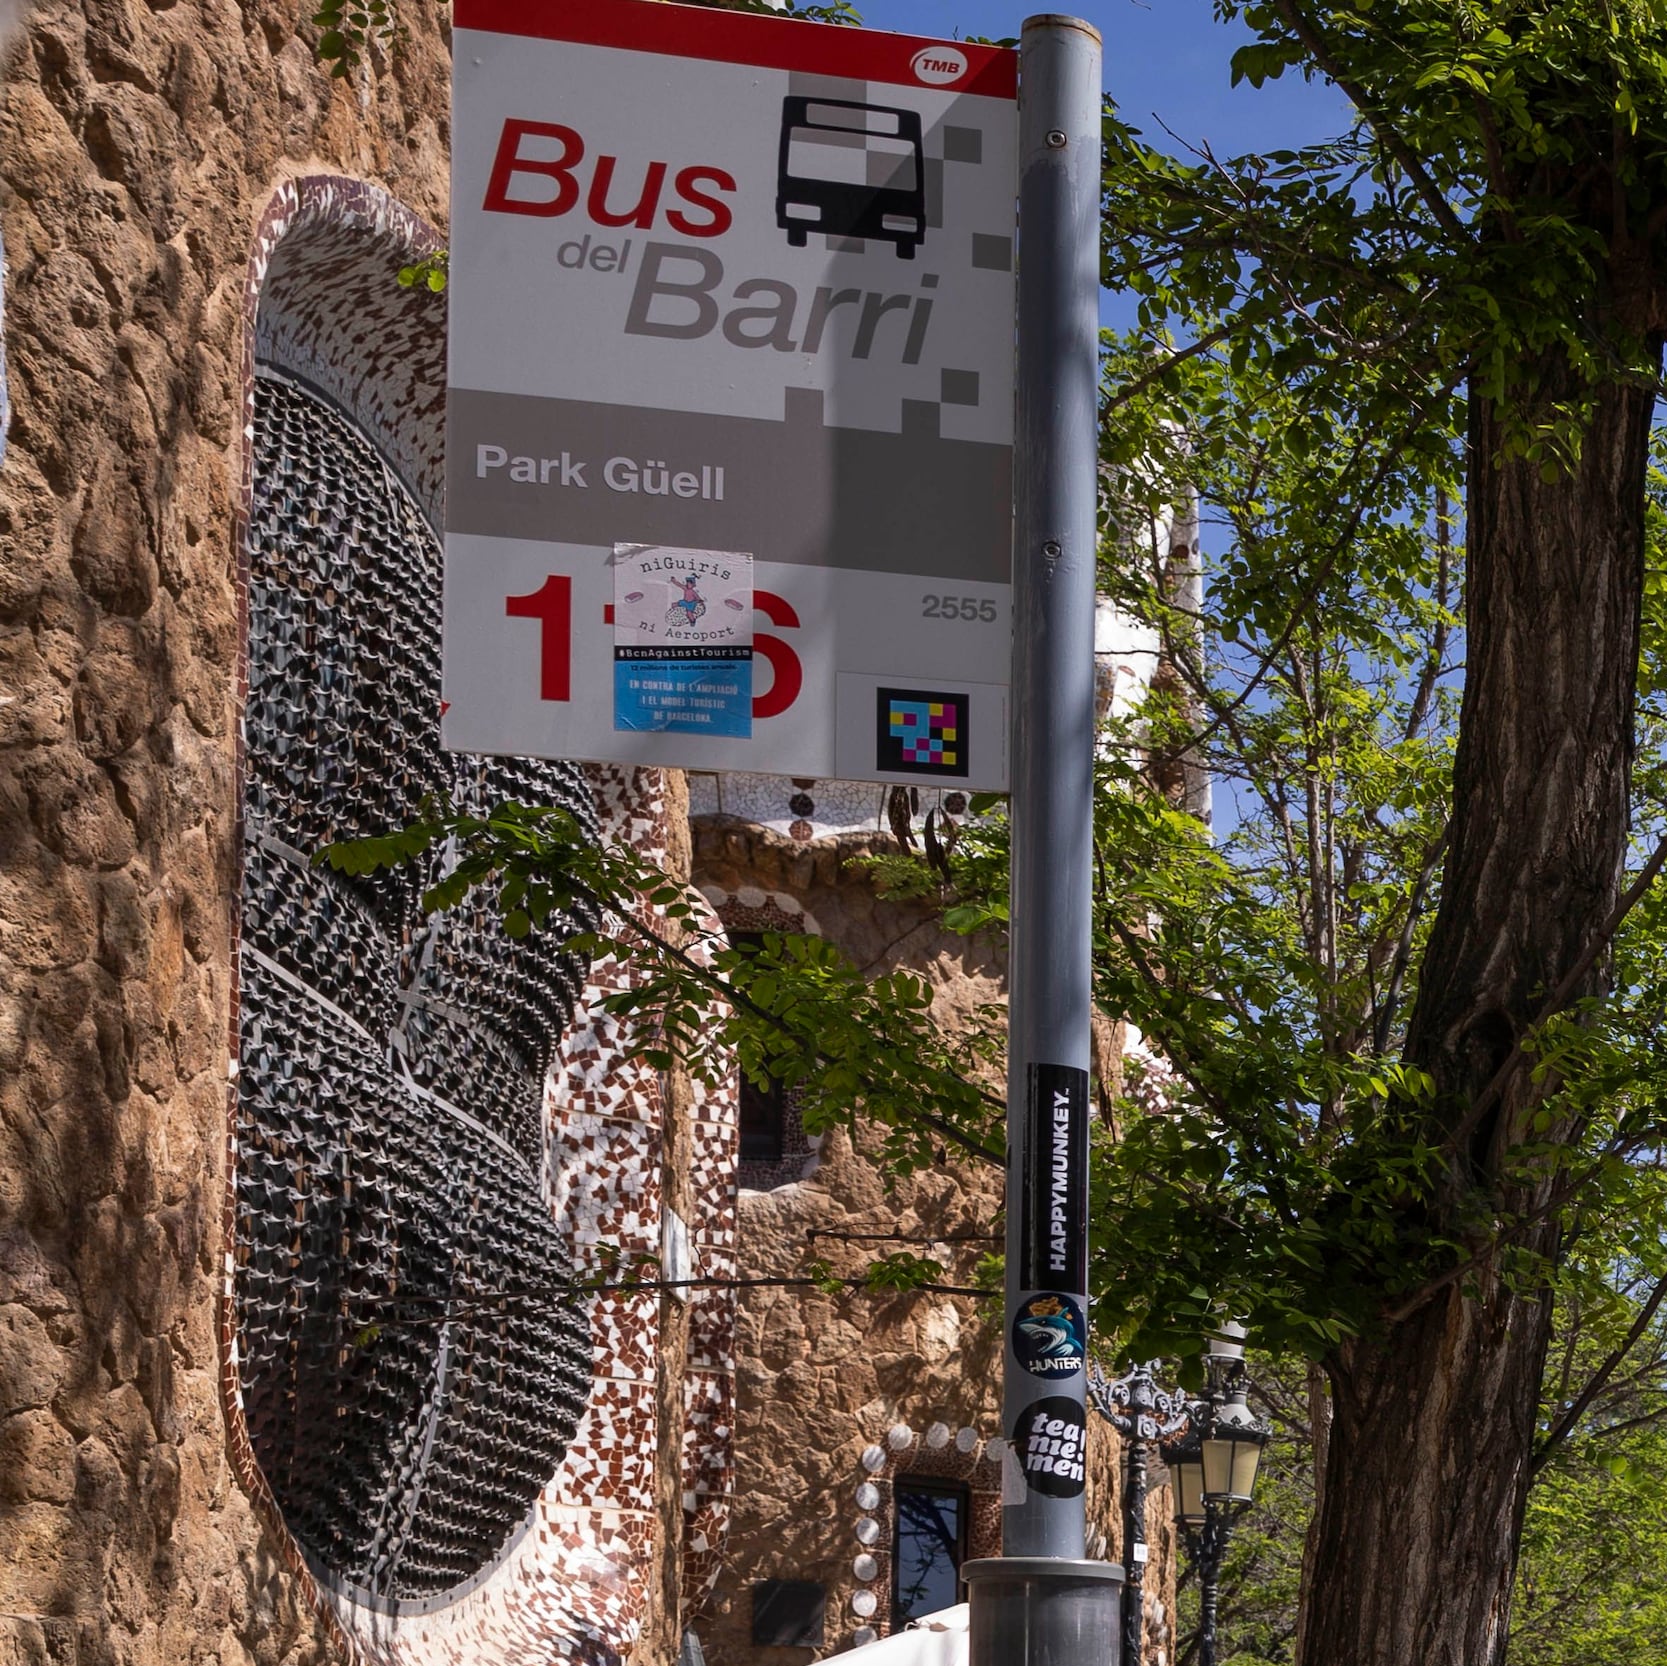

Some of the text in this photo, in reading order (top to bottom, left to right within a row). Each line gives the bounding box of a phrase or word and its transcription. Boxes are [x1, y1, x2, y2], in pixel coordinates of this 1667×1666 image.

[922, 58, 960, 74] TMB
[481, 117, 738, 238] Bus
[556, 233, 633, 274] del
[623, 240, 939, 365] Barri
[475, 444, 725, 501] Park Güell
[640, 557, 731, 581] niGuiris
[922, 594, 998, 624] 2555
[639, 620, 735, 642] ni Aeroport
[505, 575, 801, 718] 16
[648, 695, 658, 706] EL
[1029, 1357, 1082, 1373] HUNTERS
[1031, 1412, 1080, 1441] tea
[1027, 1453, 1084, 1481] men
